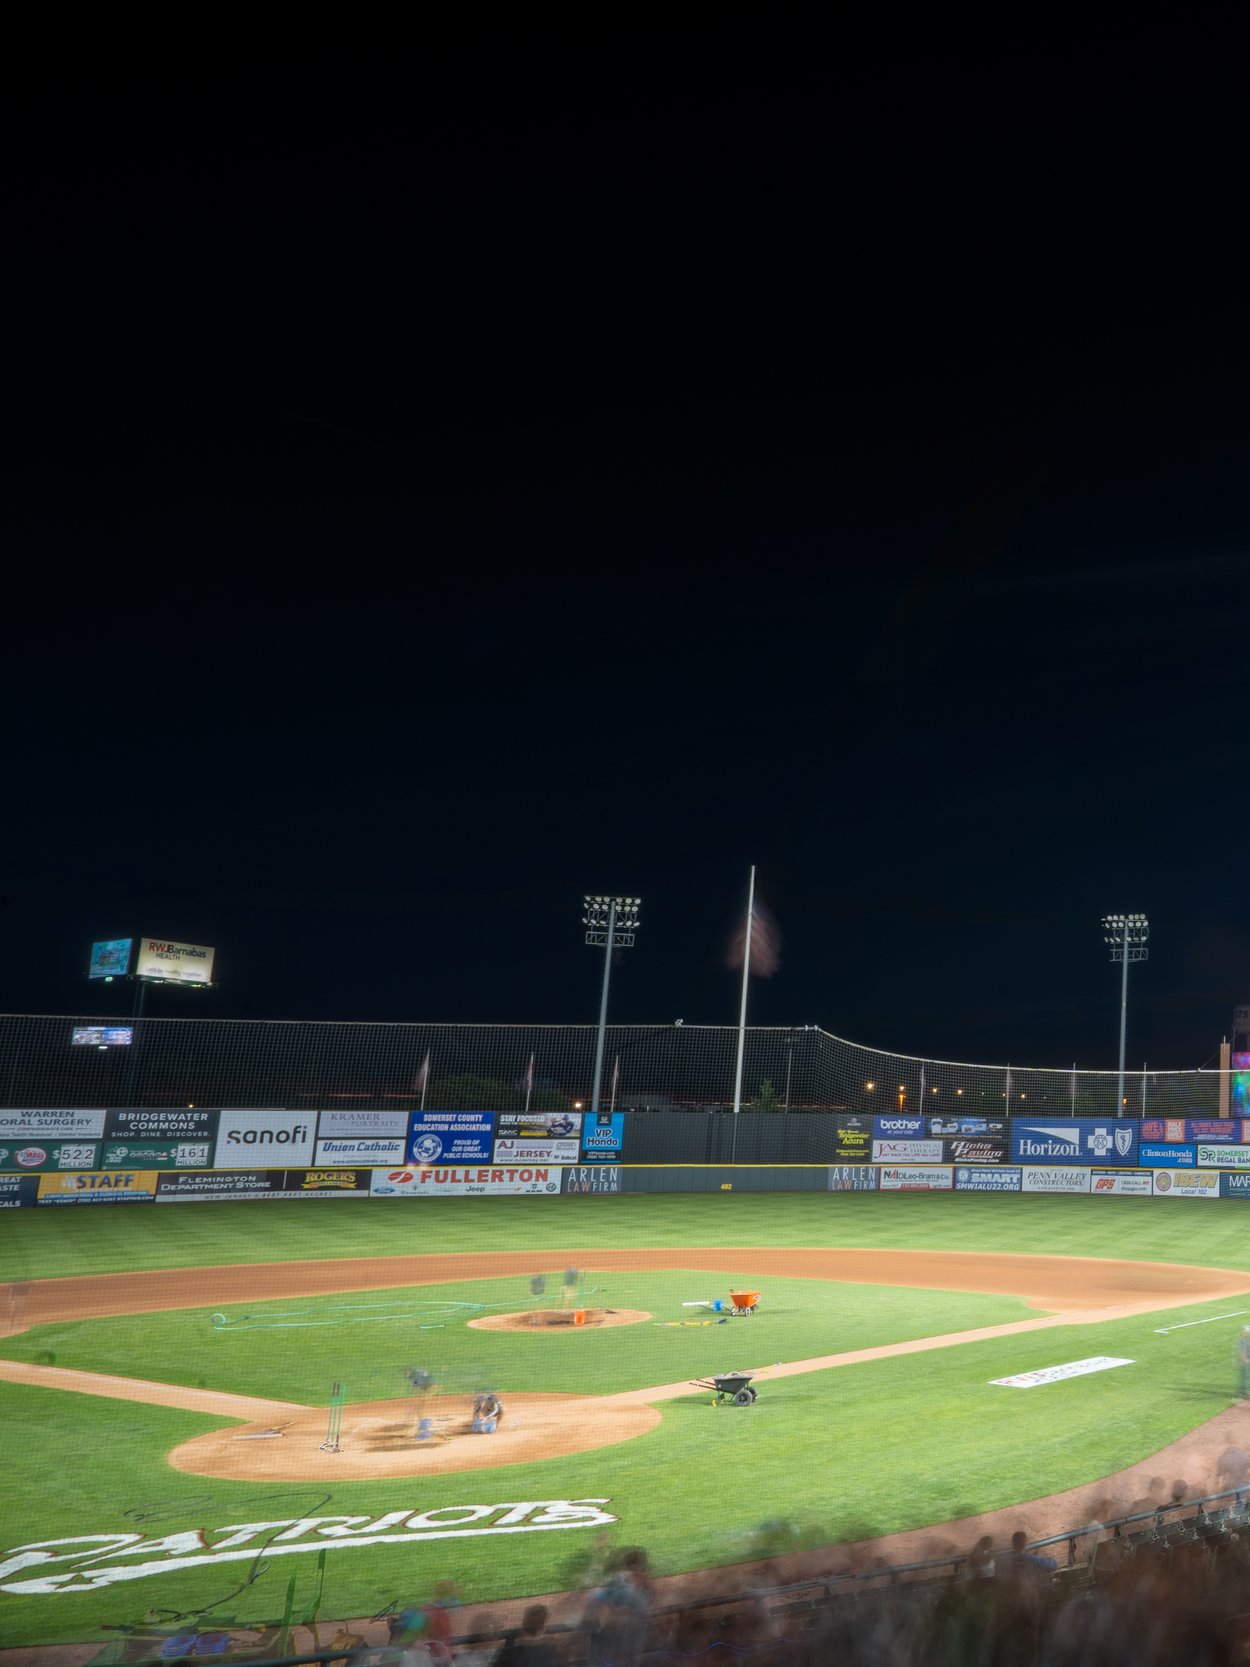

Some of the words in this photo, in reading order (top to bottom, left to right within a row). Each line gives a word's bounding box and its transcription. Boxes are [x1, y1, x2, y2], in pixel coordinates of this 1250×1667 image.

[149, 942, 207, 959] RWJBarnabas
[155, 952, 181, 961] HEALTH
[119, 1113, 208, 1121] BRIDGEWATER
[331, 1113, 381, 1121] KRAMER
[423, 1114, 456, 1122] SOMERSET
[457, 1114, 483, 1122] COUNTY
[129, 1122, 196, 1130] COMMONS
[880, 1119, 921, 1130] brother
[227, 1126, 307, 1144] sanofi
[595, 1129, 612, 1138] VIP
[323, 1142, 355, 1152] Union
[356, 1142, 401, 1152] Catholic
[498, 1141, 514, 1149] AJ
[586, 1138, 618, 1147] Honda
[874, 1143, 907, 1158] JAG
[1019, 1140, 1080, 1156] Horizon
[514, 1150, 552, 1158] JERSEY
[1142, 1149, 1193, 1158] ClintonHonda
[178, 1175, 257, 1184] FLEMINGTON
[305, 1171, 357, 1183] ROGER'S
[420, 1169, 549, 1183] FULLERTON
[568, 1168, 618, 1182] ARLEN
[833, 1168, 876, 1181] ARLEN
[884, 1169, 898, 1180] NAI
[971, 1173, 1021, 1183] SMART
[1028, 1171, 1053, 1179] PENN
[1053, 1172, 1088, 1180] VALLEY
[77, 1174, 135, 1189] STAFF
[832, 1180, 852, 1190] LAW
[853, 1180, 876, 1190] FIRM
[1095, 1178, 1117, 1190] GPS
[1173, 1172, 1218, 1189] IBEW
[161, 1183, 235, 1191] DEPARTMENT
[236, 1181, 271, 1189] STORE
[466, 1185, 485, 1193] Jeep
[567, 1182, 592, 1192] LAW
[592, 1182, 618, 1192] FIRM
[956, 1183, 1020, 1191] SMWIALU22.ORG
[0, 1499, 620, 1580] PATRIOTS
